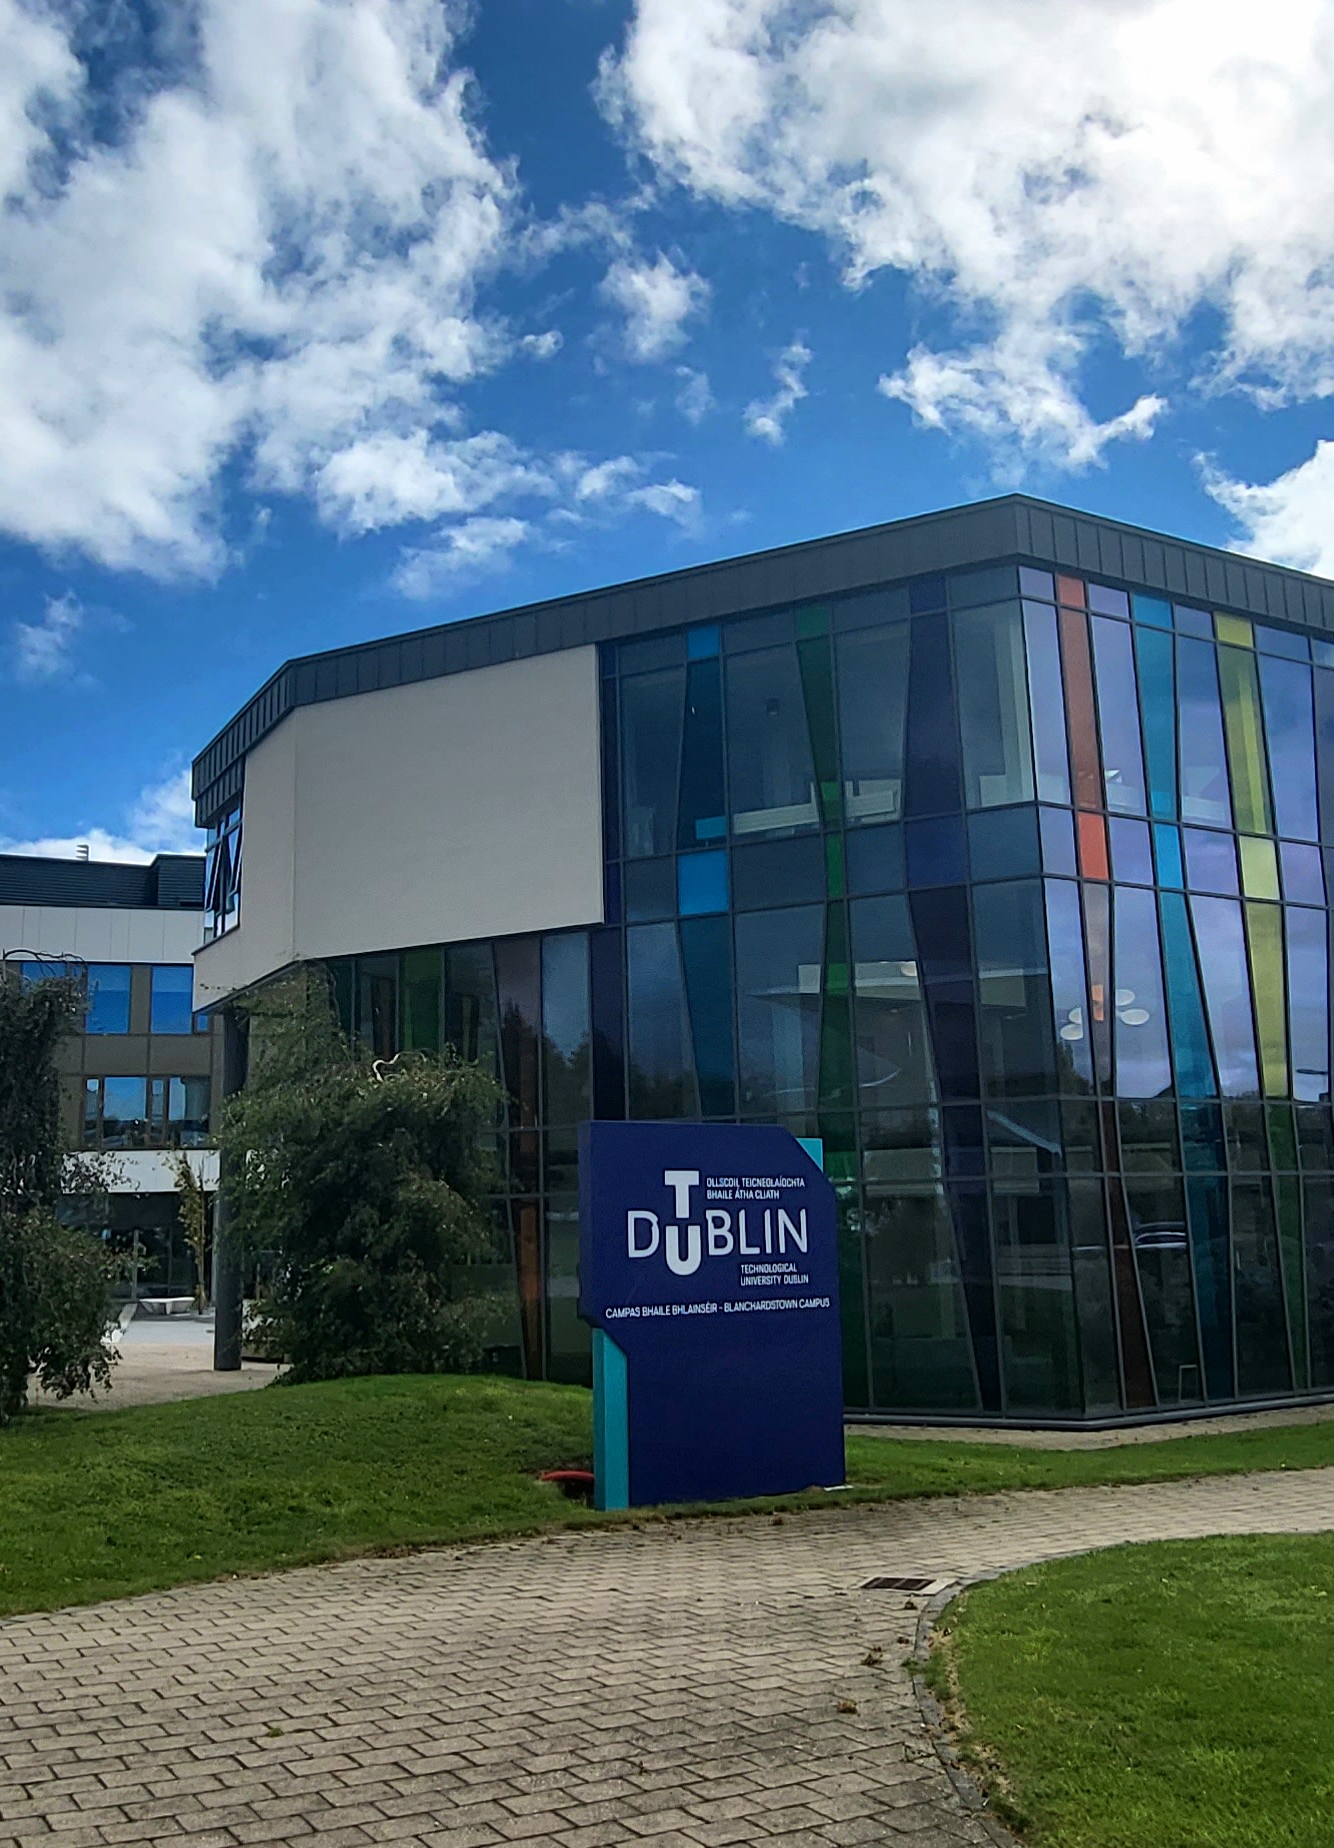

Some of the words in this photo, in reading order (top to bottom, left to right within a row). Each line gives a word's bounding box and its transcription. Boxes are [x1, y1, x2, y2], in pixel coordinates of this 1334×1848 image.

[706, 1177, 740, 1188] OLLSCOIL
[741, 1175, 805, 1188] TEICNEOLAÍOCHTA
[706, 1189, 733, 1200] BHAILE
[735, 1187, 754, 1200] ÁTHA
[754, 1189, 780, 1200] CLIATH
[740, 1262, 797, 1275] TECHNOLOGICAL
[740, 1274, 782, 1287] UNIVERSITY
[783, 1273, 809, 1285] DUBLIN
[605, 1306, 641, 1319] CAMPAS
[642, 1304, 671, 1317] BHAILE
[671, 1300, 718, 1316] BHLAINSÉIR
[723, 1299, 798, 1313] BLANCHARDSTOWN
[798, 1297, 831, 1309] CAMPUS
